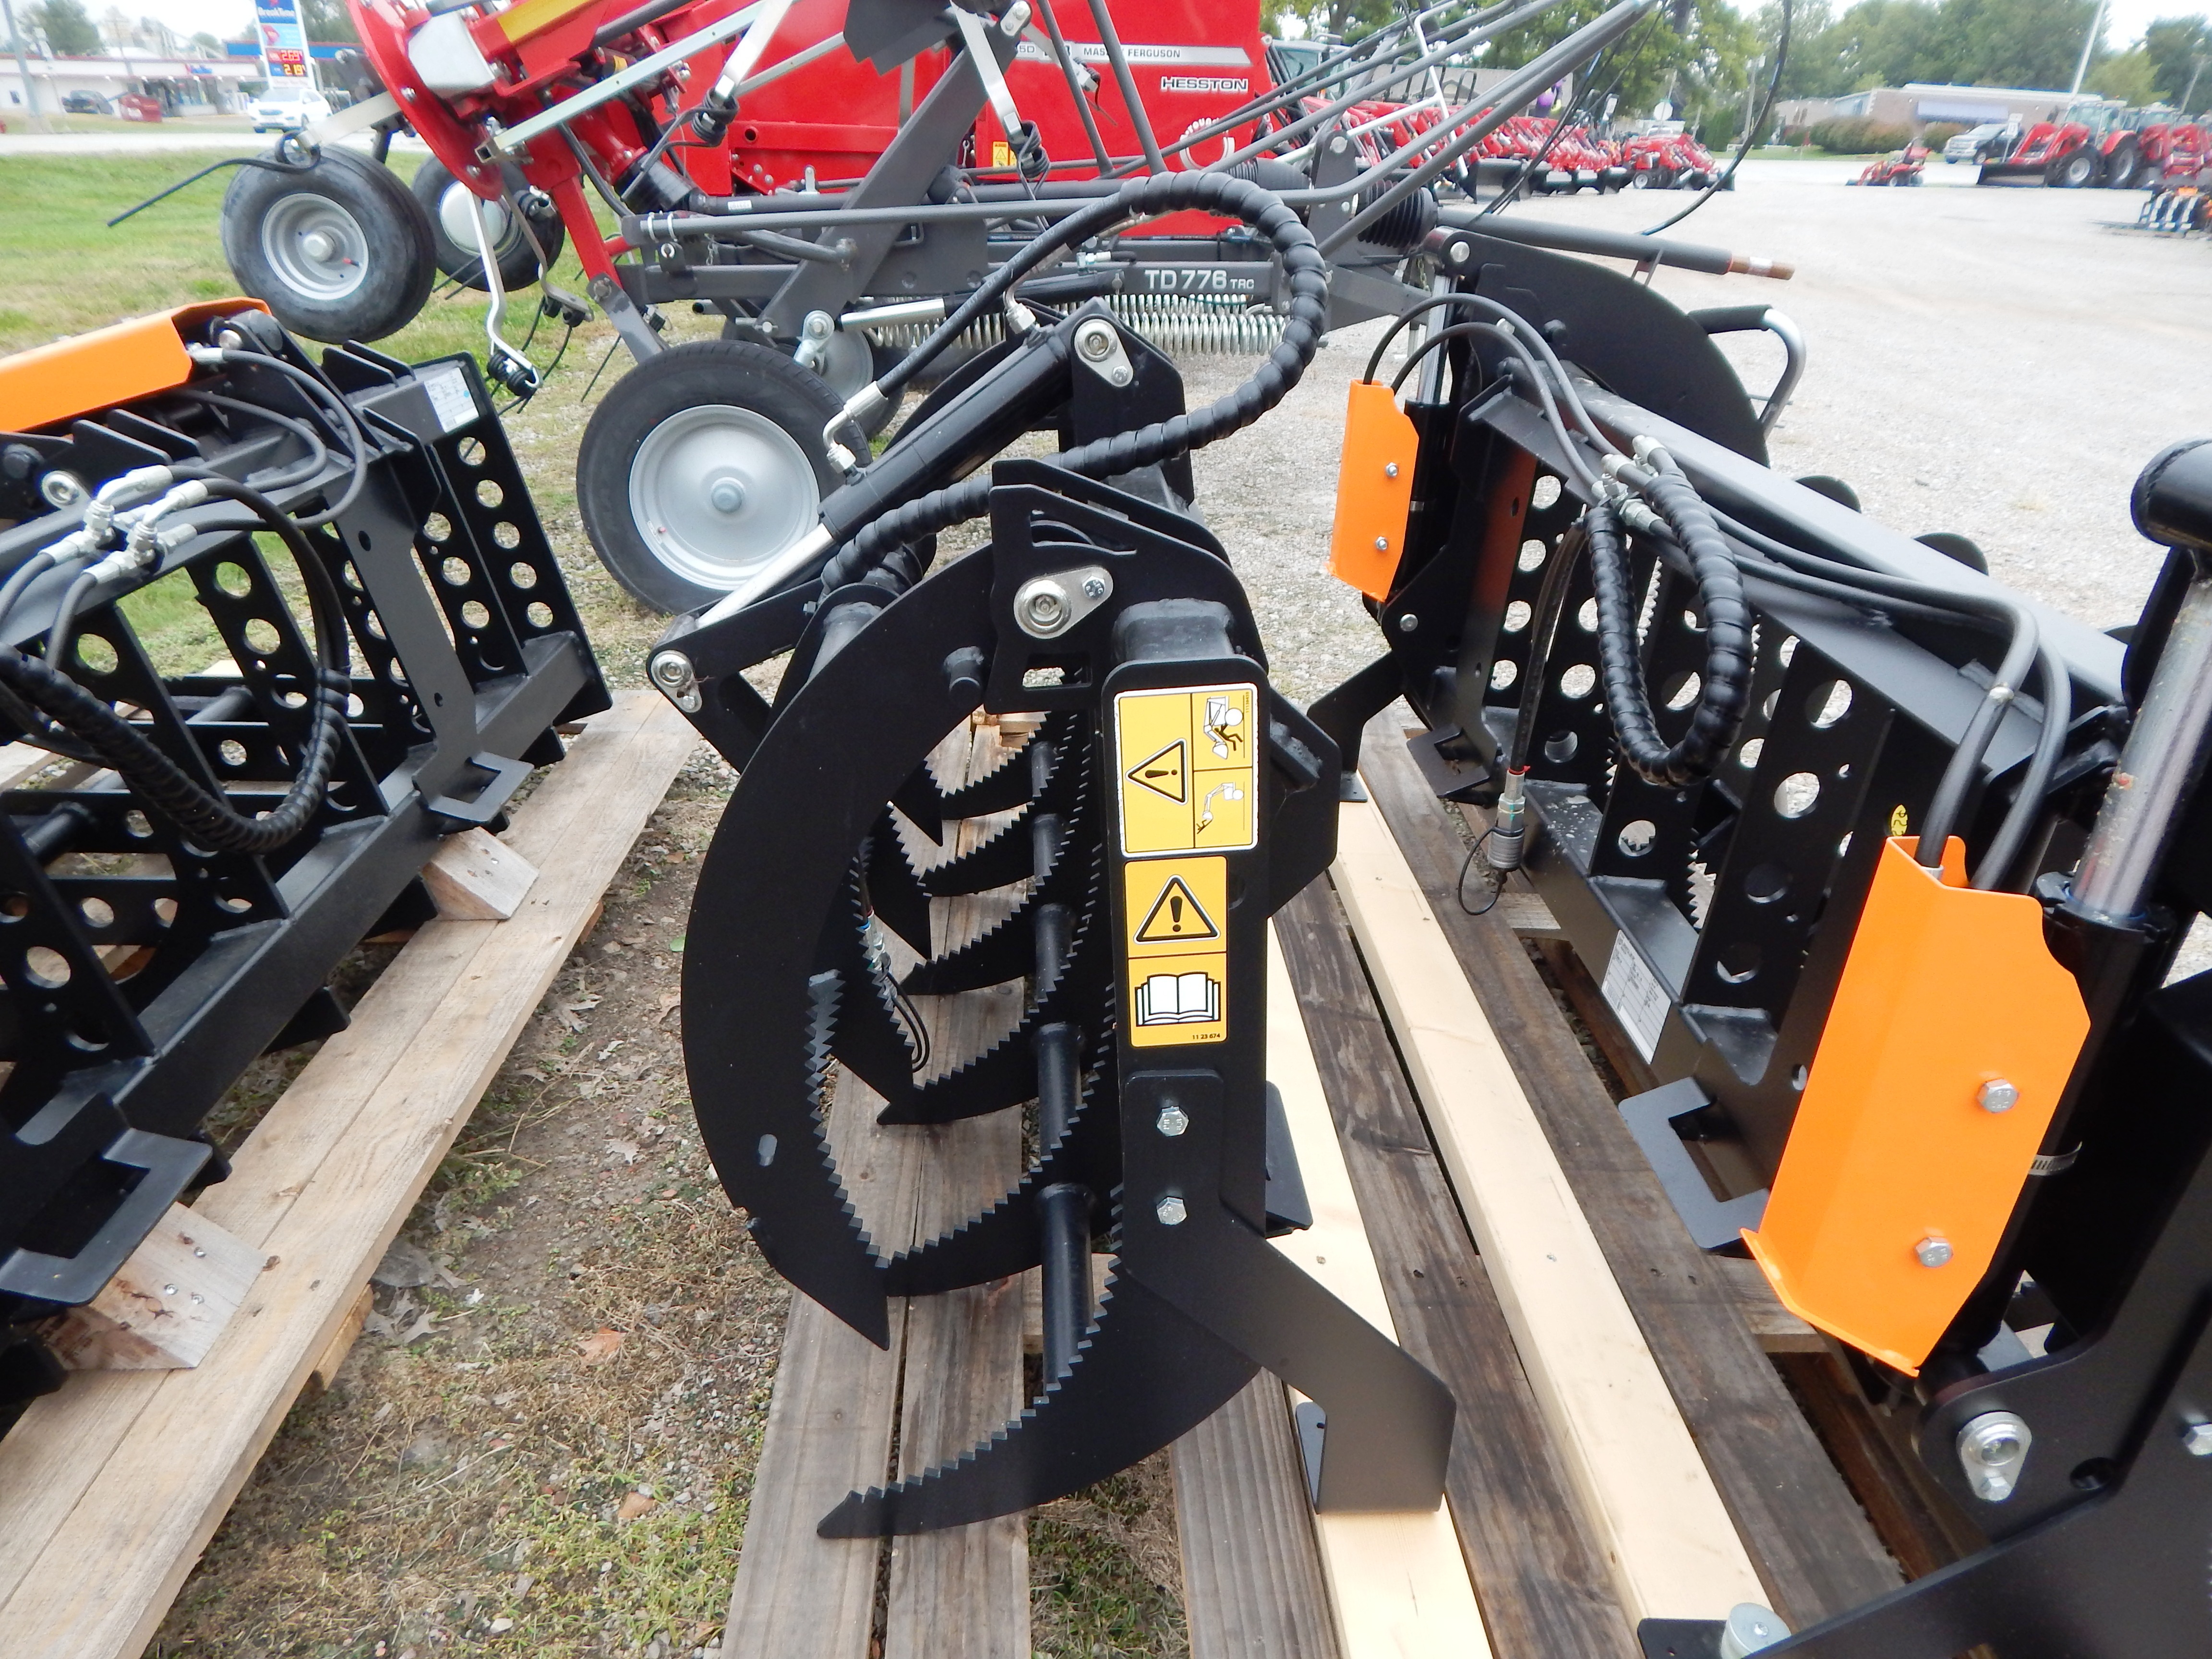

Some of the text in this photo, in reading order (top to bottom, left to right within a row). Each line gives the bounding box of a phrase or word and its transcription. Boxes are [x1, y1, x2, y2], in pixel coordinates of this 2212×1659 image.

[1128, 48, 1181, 58] FERGUSON
[1162, 77, 1248, 91] HESSTON
[1230, 278, 1254, 289] TRC
